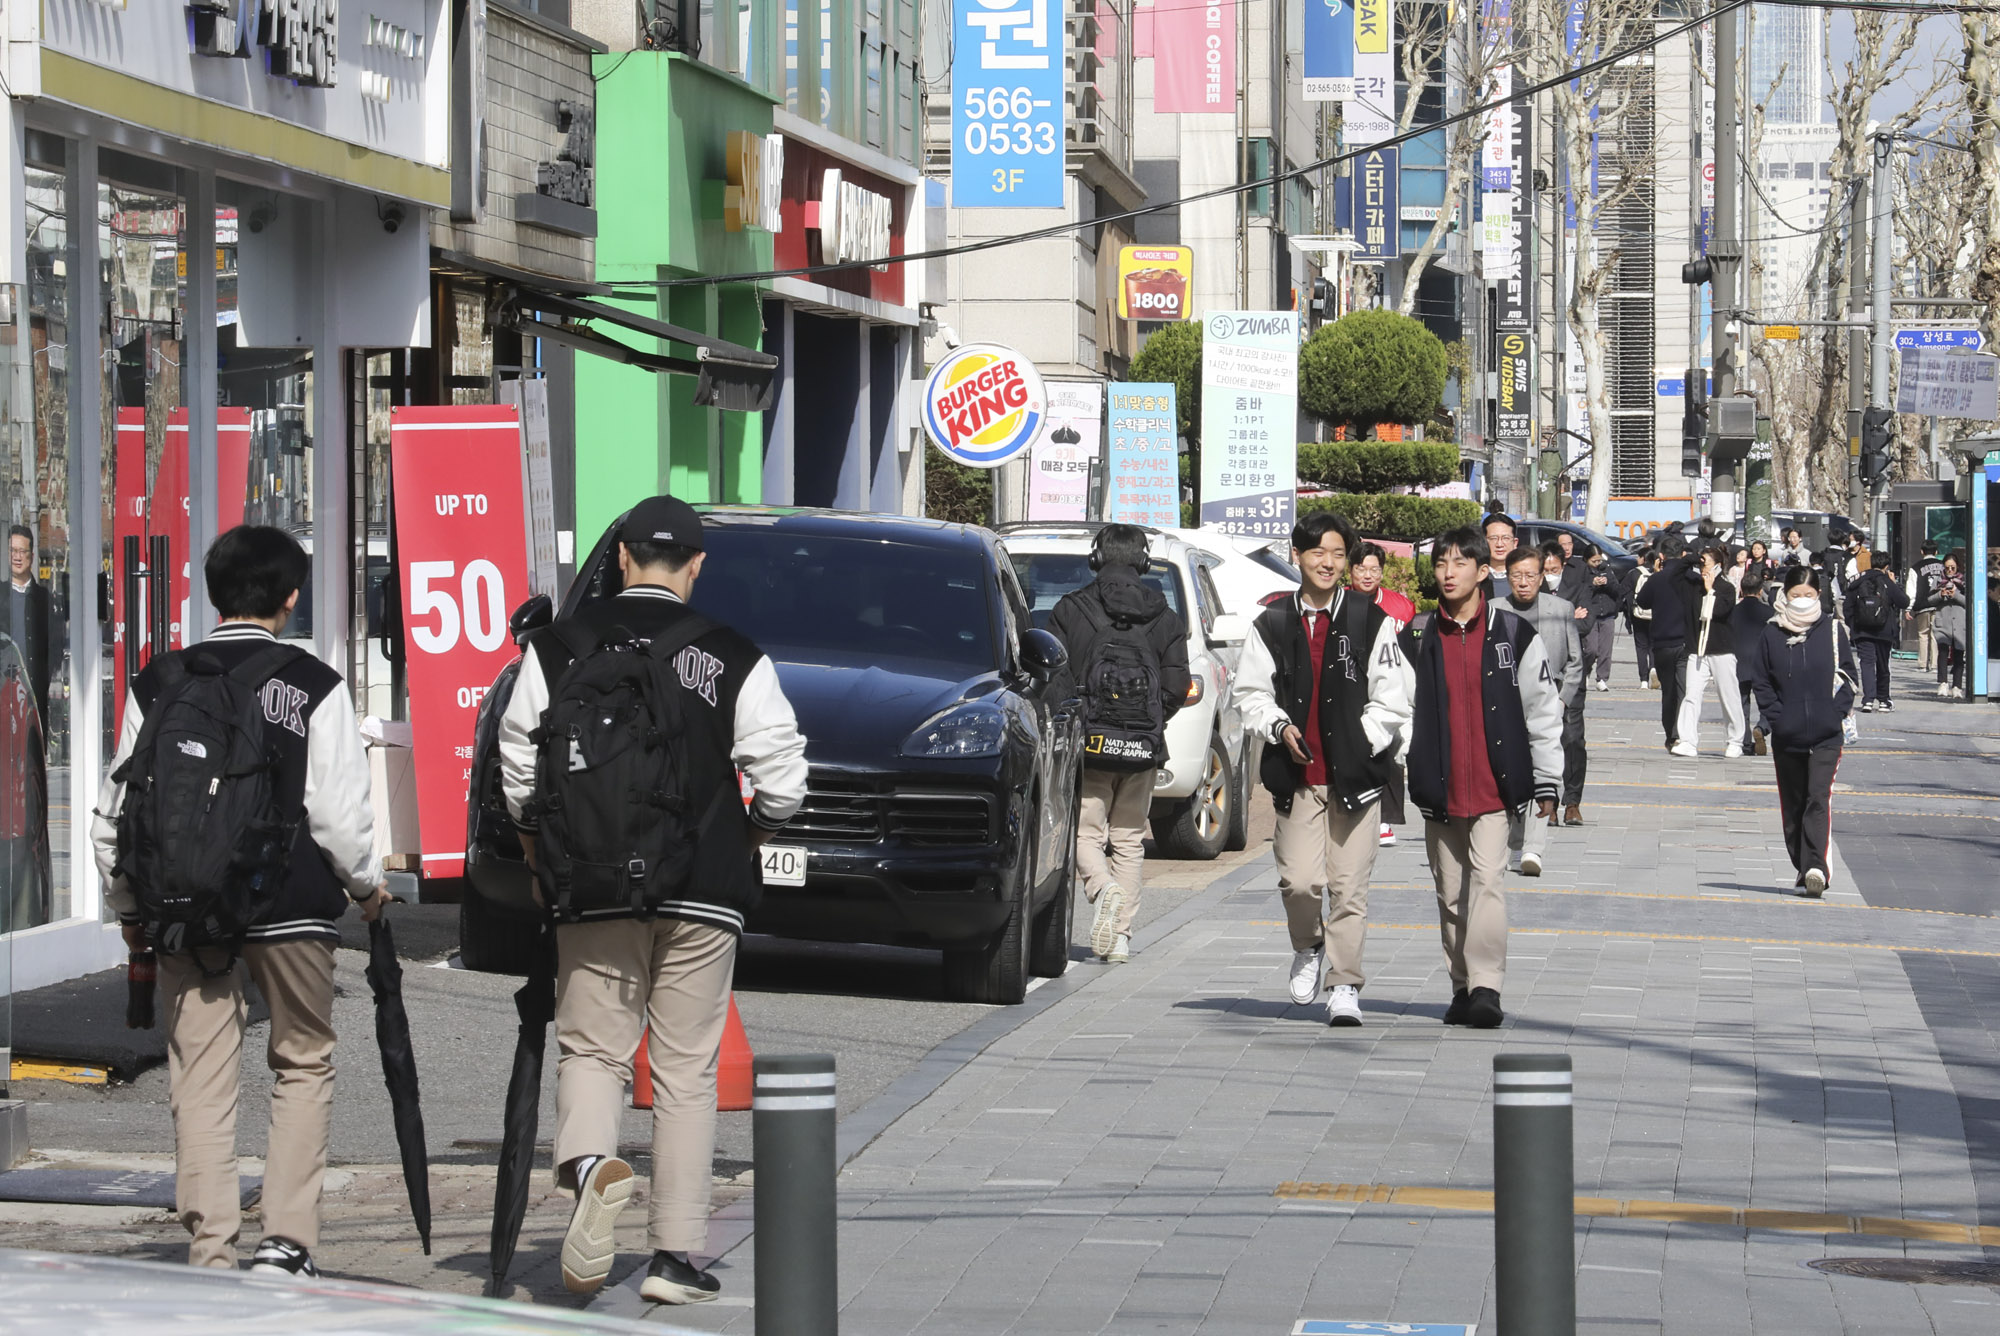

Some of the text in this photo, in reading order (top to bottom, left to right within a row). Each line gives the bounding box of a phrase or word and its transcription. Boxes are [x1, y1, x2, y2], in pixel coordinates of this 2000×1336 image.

[1206, 35, 1221, 103] COFFEE
[964, 87, 1051, 120] 566-
[1348, 122, 1390, 131] 556-1988
[964, 122, 1056, 155] 0533
[992, 169, 1025, 192] 3F
[1365, 150, 1385, 244] 스터디카페
[1236, 317, 1291, 336] ZUMBA
[1899, 331, 1978, 346] 302 삼성로 240
[1501, 355, 1514, 412] KIDSBAY
[1515, 358, 1527, 392] SWIS
[936, 360, 1019, 421] BURGER
[947, 378, 1028, 448] KING
[1235, 397, 1262, 411] 줌바
[1113, 417, 1171, 433] 수학클리닉
[1228, 429, 1269, 440] 그룹레슨
[1228, 444, 1269, 455] 방송댄스
[1041, 460, 1088, 473] 매장 모두
[1120, 458, 1168, 471] 수능/내신
[1228, 459, 1269, 470] 각종대관
[1220, 473, 1275, 487] 문의환영
[435, 493, 488, 516] UP TO
[1260, 496, 1290, 518] 3F
[410, 558, 507, 655] 50
[1378, 642, 1401, 670] 40
[1539, 658, 1553, 686] 4
